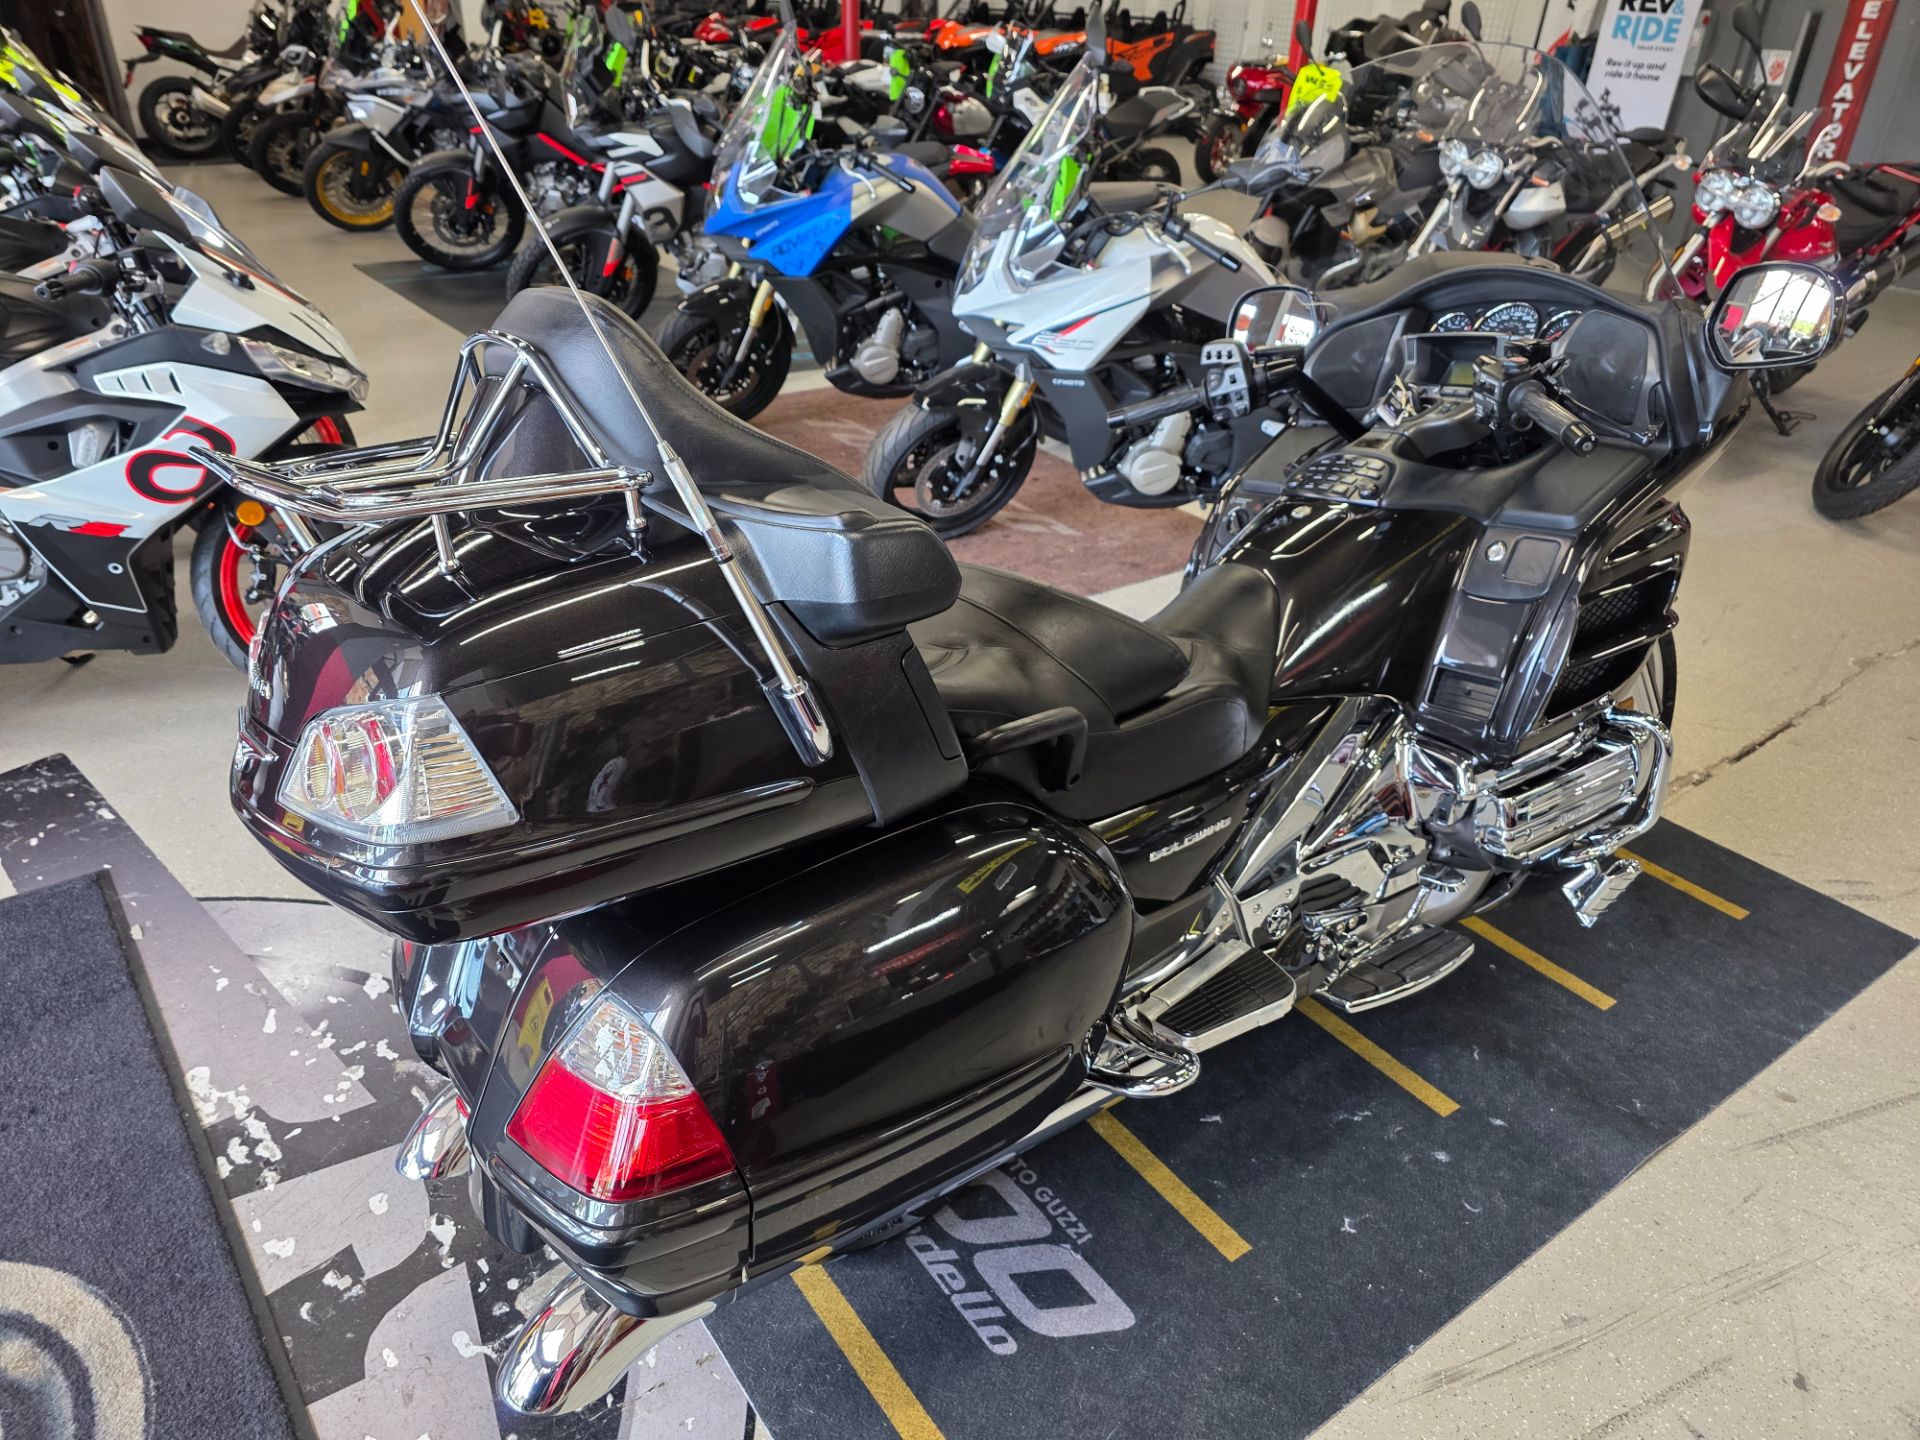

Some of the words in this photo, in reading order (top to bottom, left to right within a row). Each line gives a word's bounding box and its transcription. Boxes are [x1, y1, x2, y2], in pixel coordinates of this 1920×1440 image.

[1612, 14, 1682, 48] RIDE
[1604, 69, 1623, 79] ride
[1625, 70, 1632, 79] it
[1633, 70, 1660, 82] home
[1605, 57, 1622, 67] Rev
[1624, 58, 1631, 67] it
[1632, 62, 1645, 71] up
[1646, 62, 1667, 71] and
[1034, 1187, 1093, 1245] GUZZI
